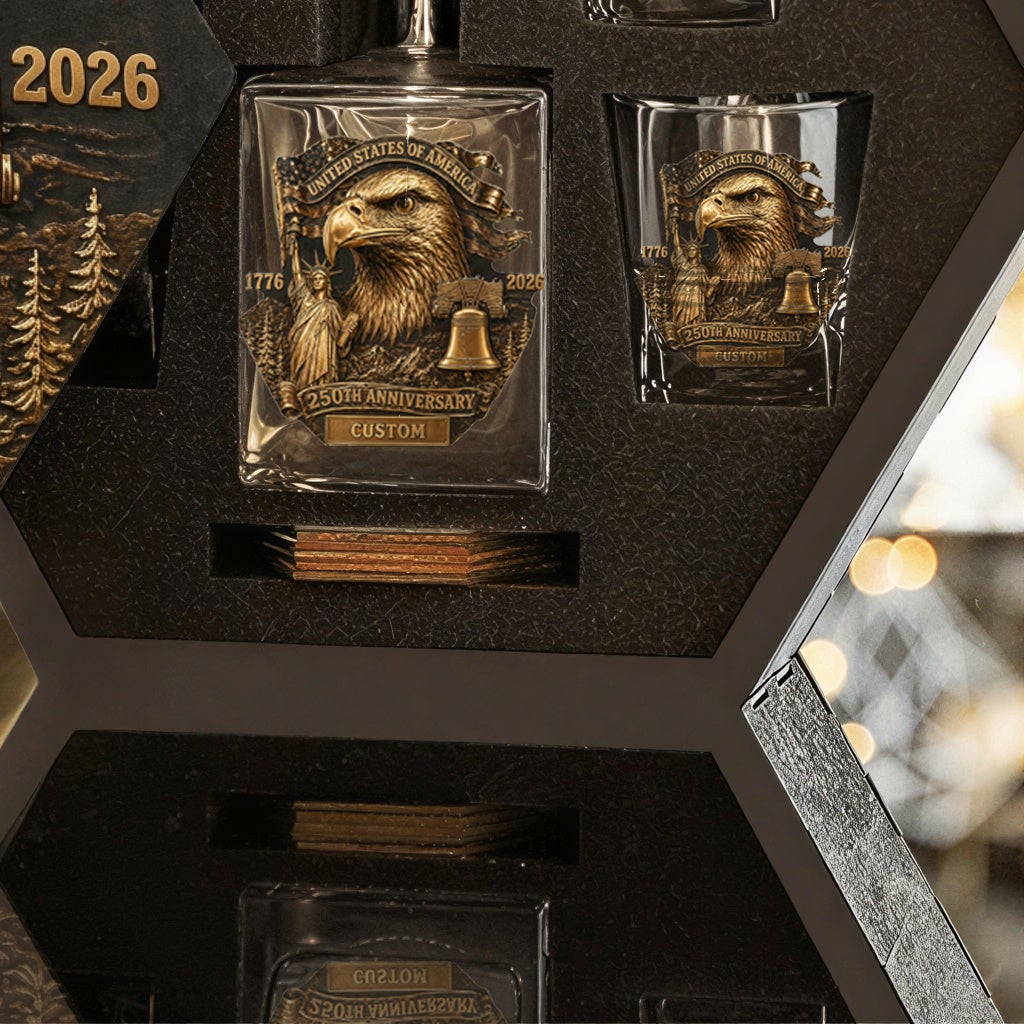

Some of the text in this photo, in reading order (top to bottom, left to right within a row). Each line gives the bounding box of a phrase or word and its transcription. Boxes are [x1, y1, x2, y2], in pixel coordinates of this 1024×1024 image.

[11, 45, 160, 110] 2026
[307, 141, 477, 196] UNITED STATES OF AMERICA
[684, 153, 805, 192] UNITED STATES OF AMERICA
[641, 246, 668, 258] 1776
[824, 246, 850, 258] 2026
[245, 272, 284, 290] 1776
[506, 273, 544, 291] 2026
[685, 326, 802, 342] 250TH ANNIVERSARY
[715, 351, 768, 362] CUSTOM
[307, 388, 475, 411] 250TH ANNIVERSARY
[351, 422, 426, 439] CUSTOM
